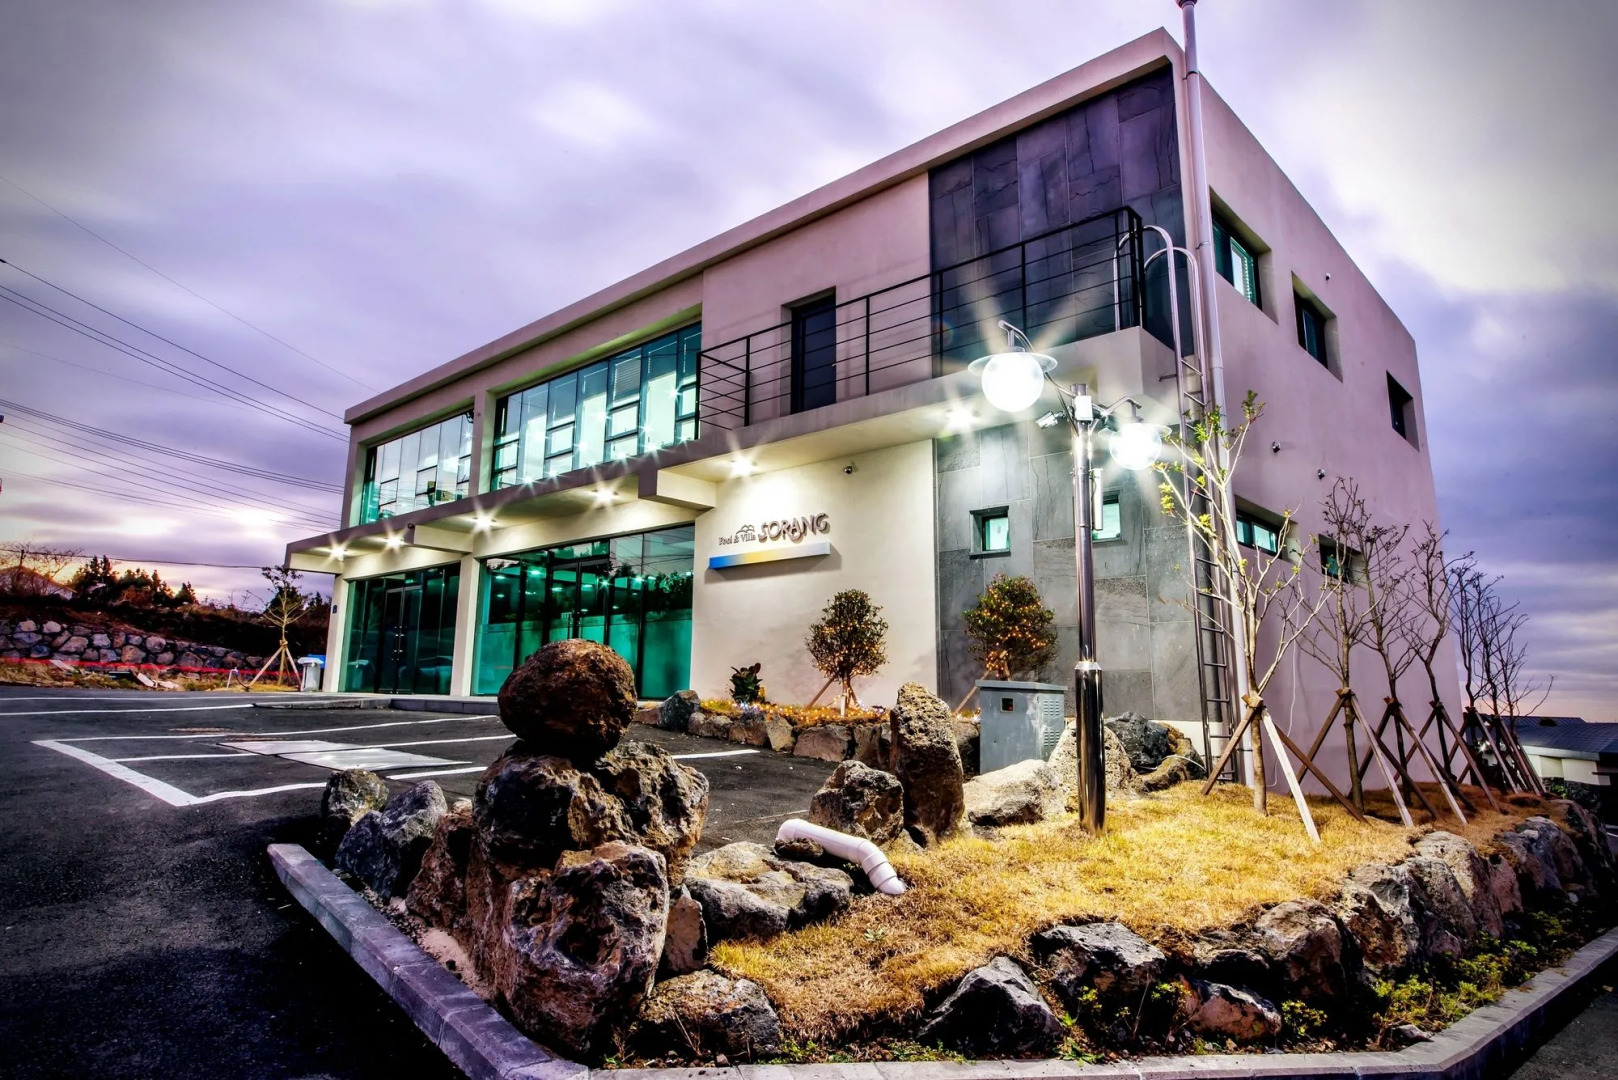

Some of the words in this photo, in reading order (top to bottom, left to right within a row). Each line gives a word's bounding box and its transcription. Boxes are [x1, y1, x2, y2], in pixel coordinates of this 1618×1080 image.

[733, 534, 740, 544] &
[740, 532, 756, 542] Villa
[758, 513, 829, 542] SORANG
